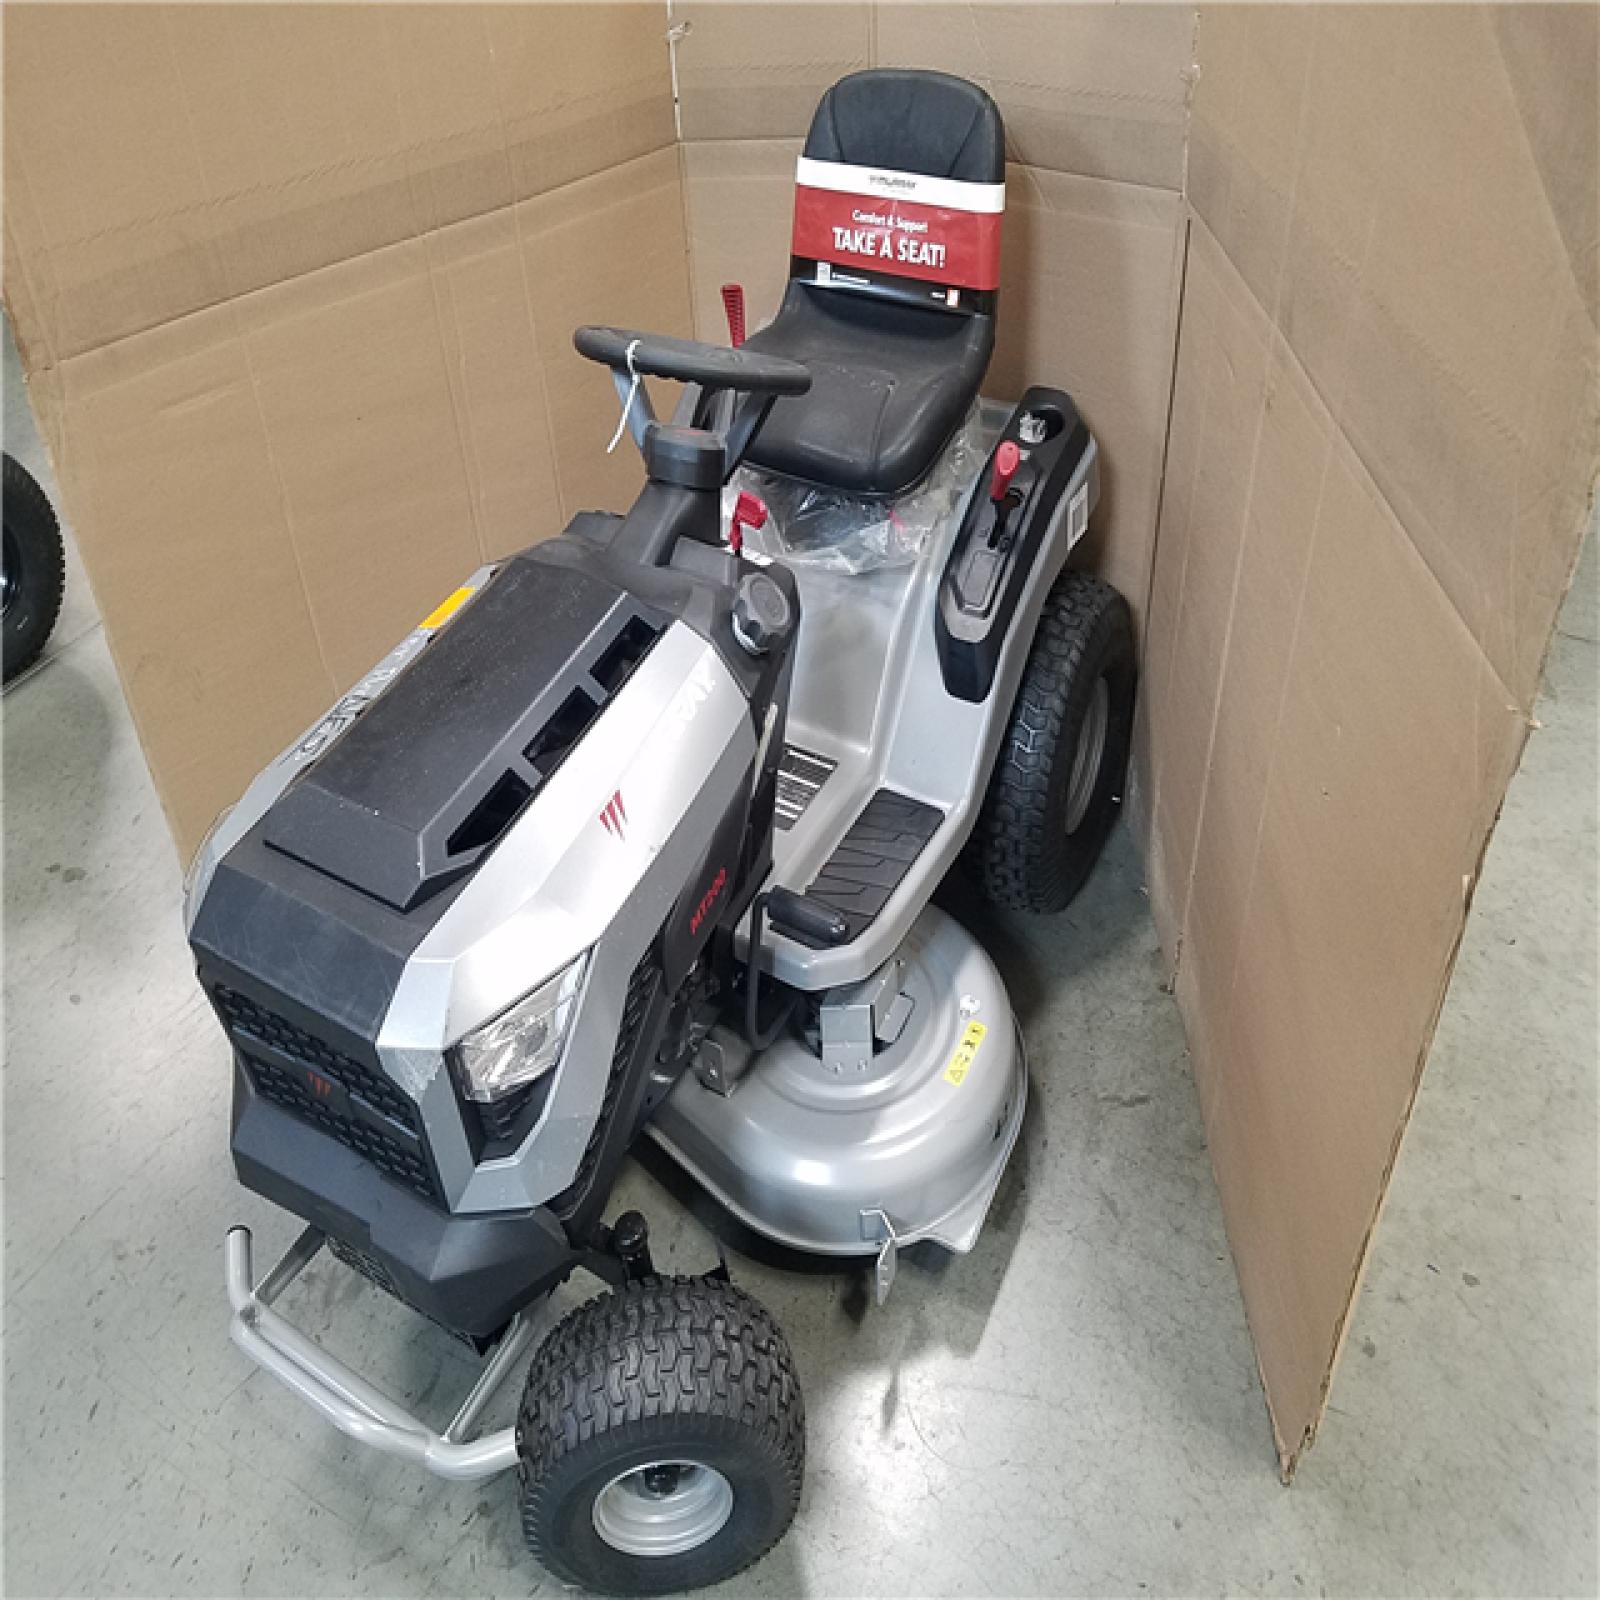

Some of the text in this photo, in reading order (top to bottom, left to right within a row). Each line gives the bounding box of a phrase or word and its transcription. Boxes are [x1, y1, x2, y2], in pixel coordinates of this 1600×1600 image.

[833, 227, 946, 268] TAKE A SEAT!
